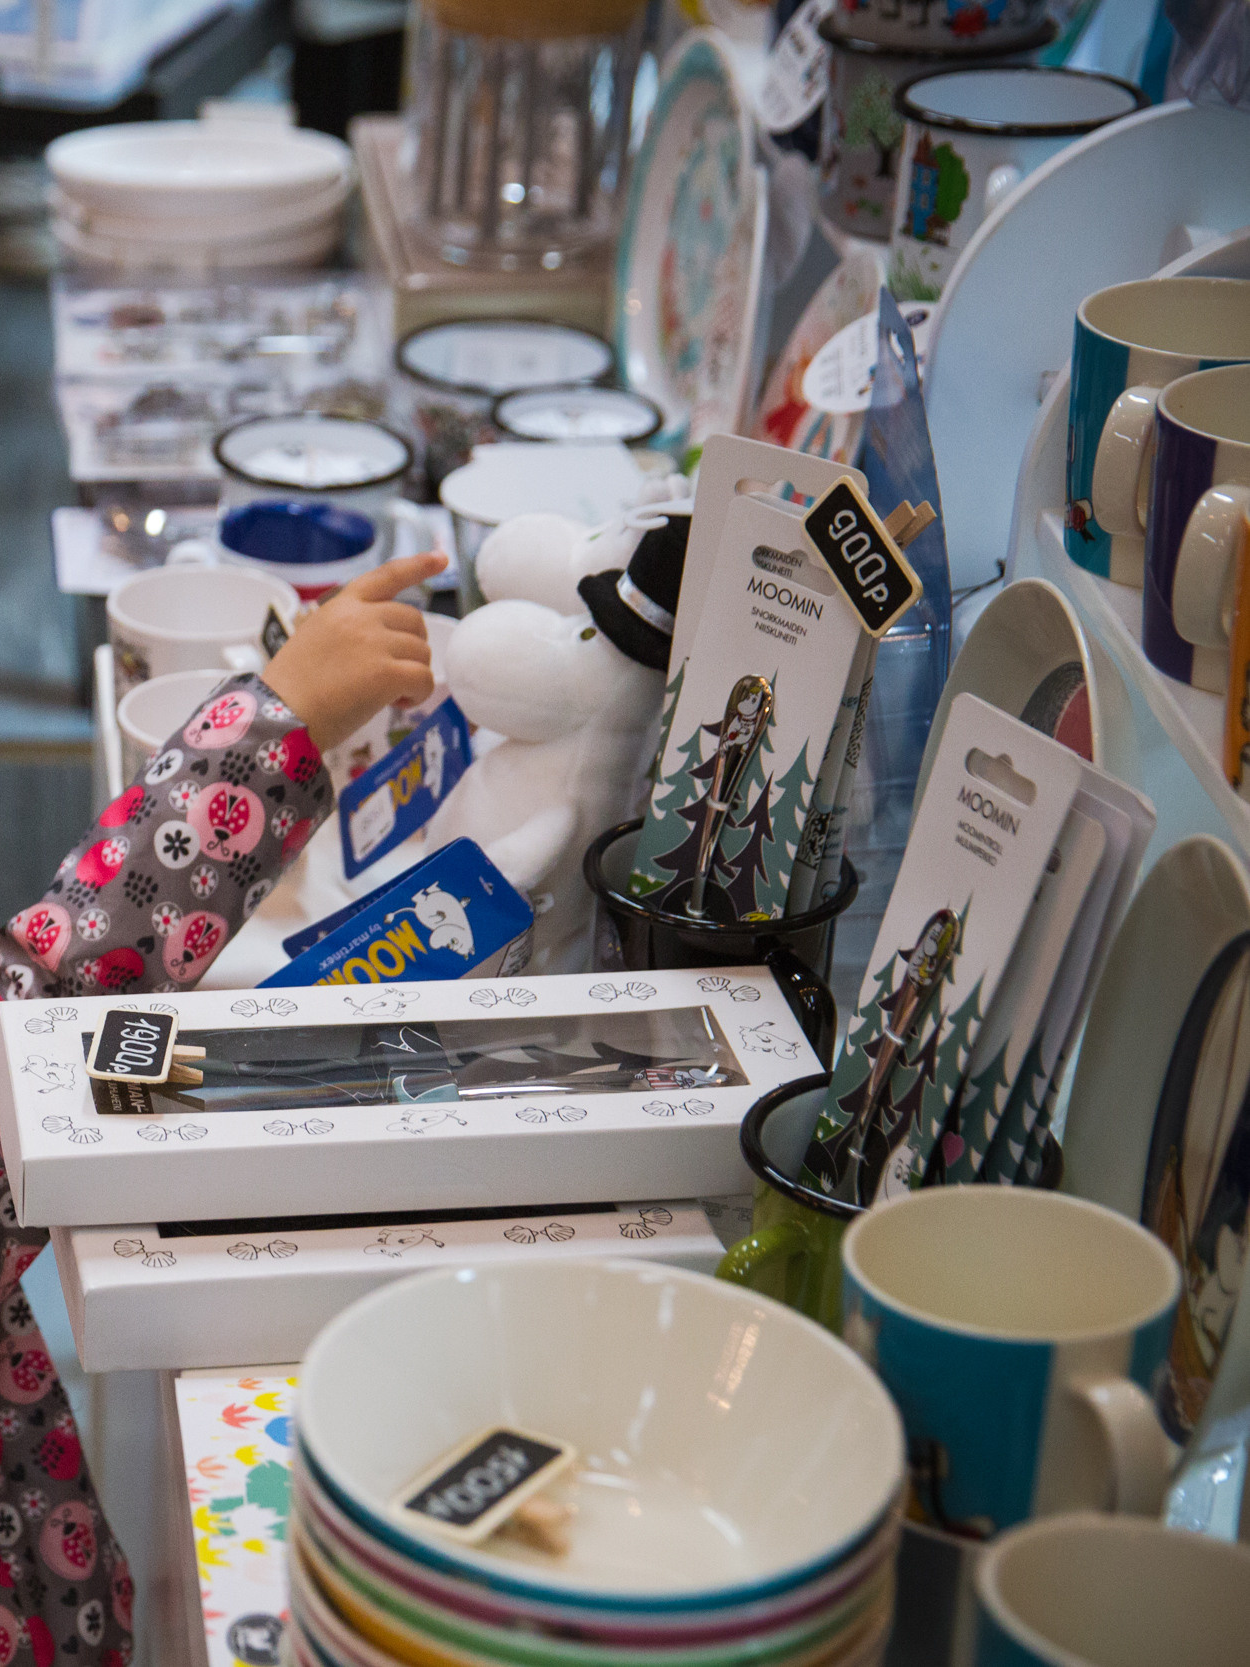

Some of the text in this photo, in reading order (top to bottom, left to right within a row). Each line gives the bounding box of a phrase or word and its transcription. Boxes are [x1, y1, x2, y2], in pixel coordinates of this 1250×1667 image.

[747, 576, 824, 621] MOOMIN
[752, 606, 807, 637] SNORKMAIDEN
[957, 785, 1021, 836] MOOMIN
